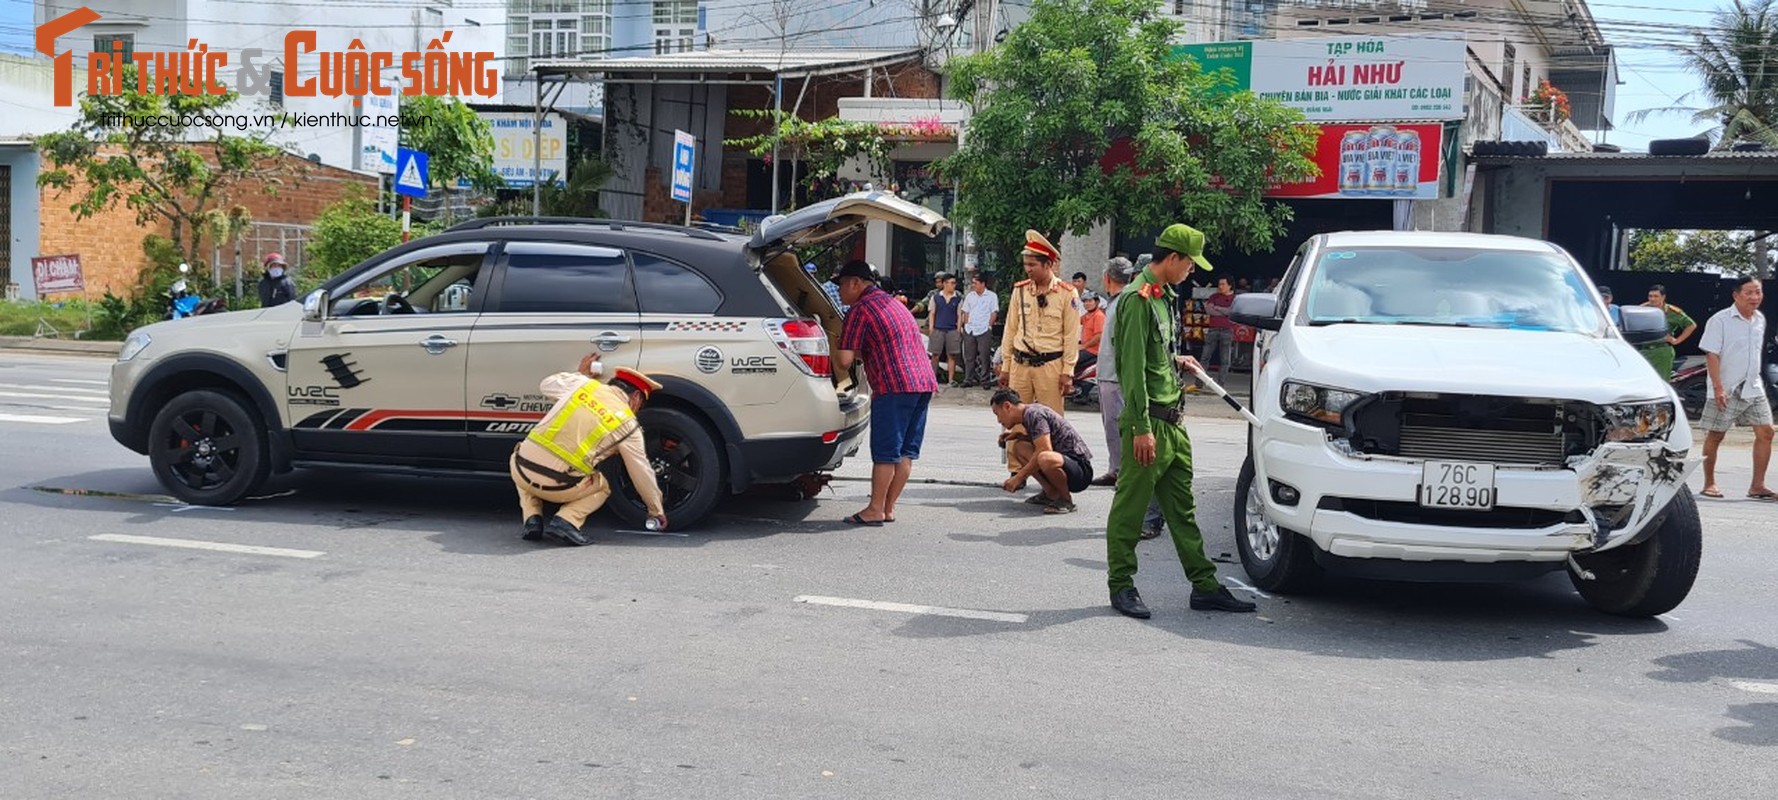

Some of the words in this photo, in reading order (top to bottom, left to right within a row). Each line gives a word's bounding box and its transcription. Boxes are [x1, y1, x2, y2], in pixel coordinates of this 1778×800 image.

[1326, 42, 1352, 57] TẠP
[1357, 39, 1384, 53] HÓA
[1308, 58, 1345, 86] HẢI
[1353, 60, 1405, 85] NHƯ
[1260, 90, 1292, 101] CHUYÊN
[1295, 88, 1312, 101] BÁN
[1315, 91, 1329, 101] BIA
[1337, 88, 1361, 100] NƯỚC
[1364, 86, 1382, 99] GIẢI
[1384, 86, 1406, 99] KHÁT
[1410, 86, 1428, 99] CÁC
[1431, 87, 1451, 100] LOẠI
[732, 356, 777, 366] WRC
[288, 386, 340, 398] WRC
[520, 402, 554, 411] CHEVR
[486, 422, 534, 432] CAPTI
[1440, 463, 1477, 484] 76C
[1426, 484, 1490, 507] 128.90
